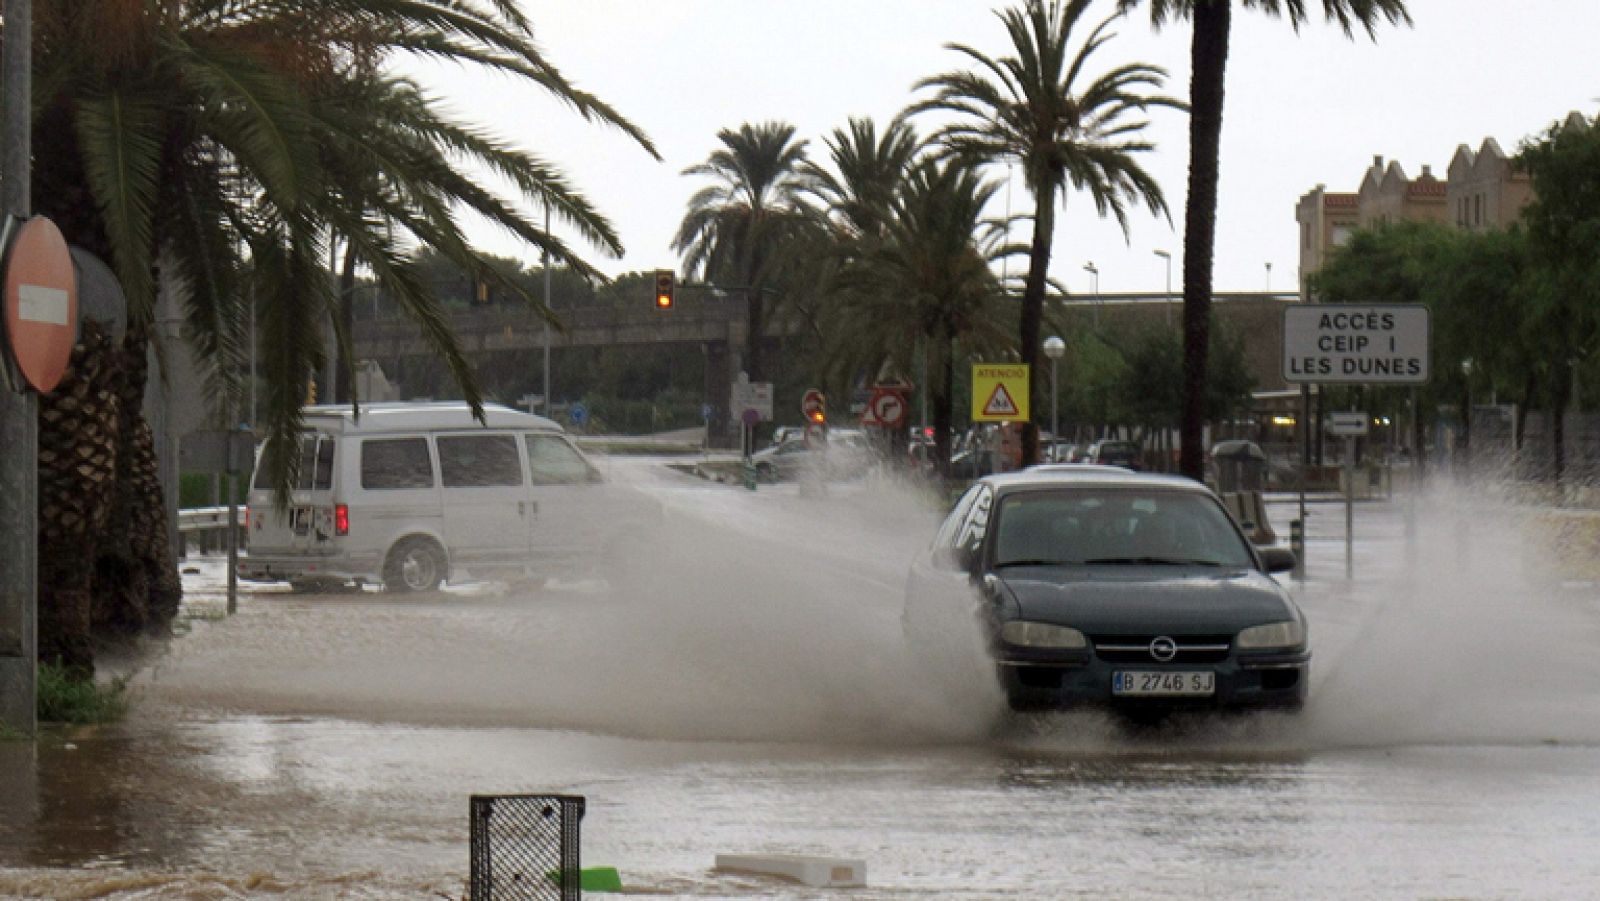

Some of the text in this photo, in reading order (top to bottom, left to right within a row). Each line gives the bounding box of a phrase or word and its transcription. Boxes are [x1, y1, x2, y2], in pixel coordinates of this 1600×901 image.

[1318, 335, 1395, 352] CEIP I
[1291, 358, 1421, 375] LES DUNES
[1124, 673, 1213, 690] B 2746 SJ
